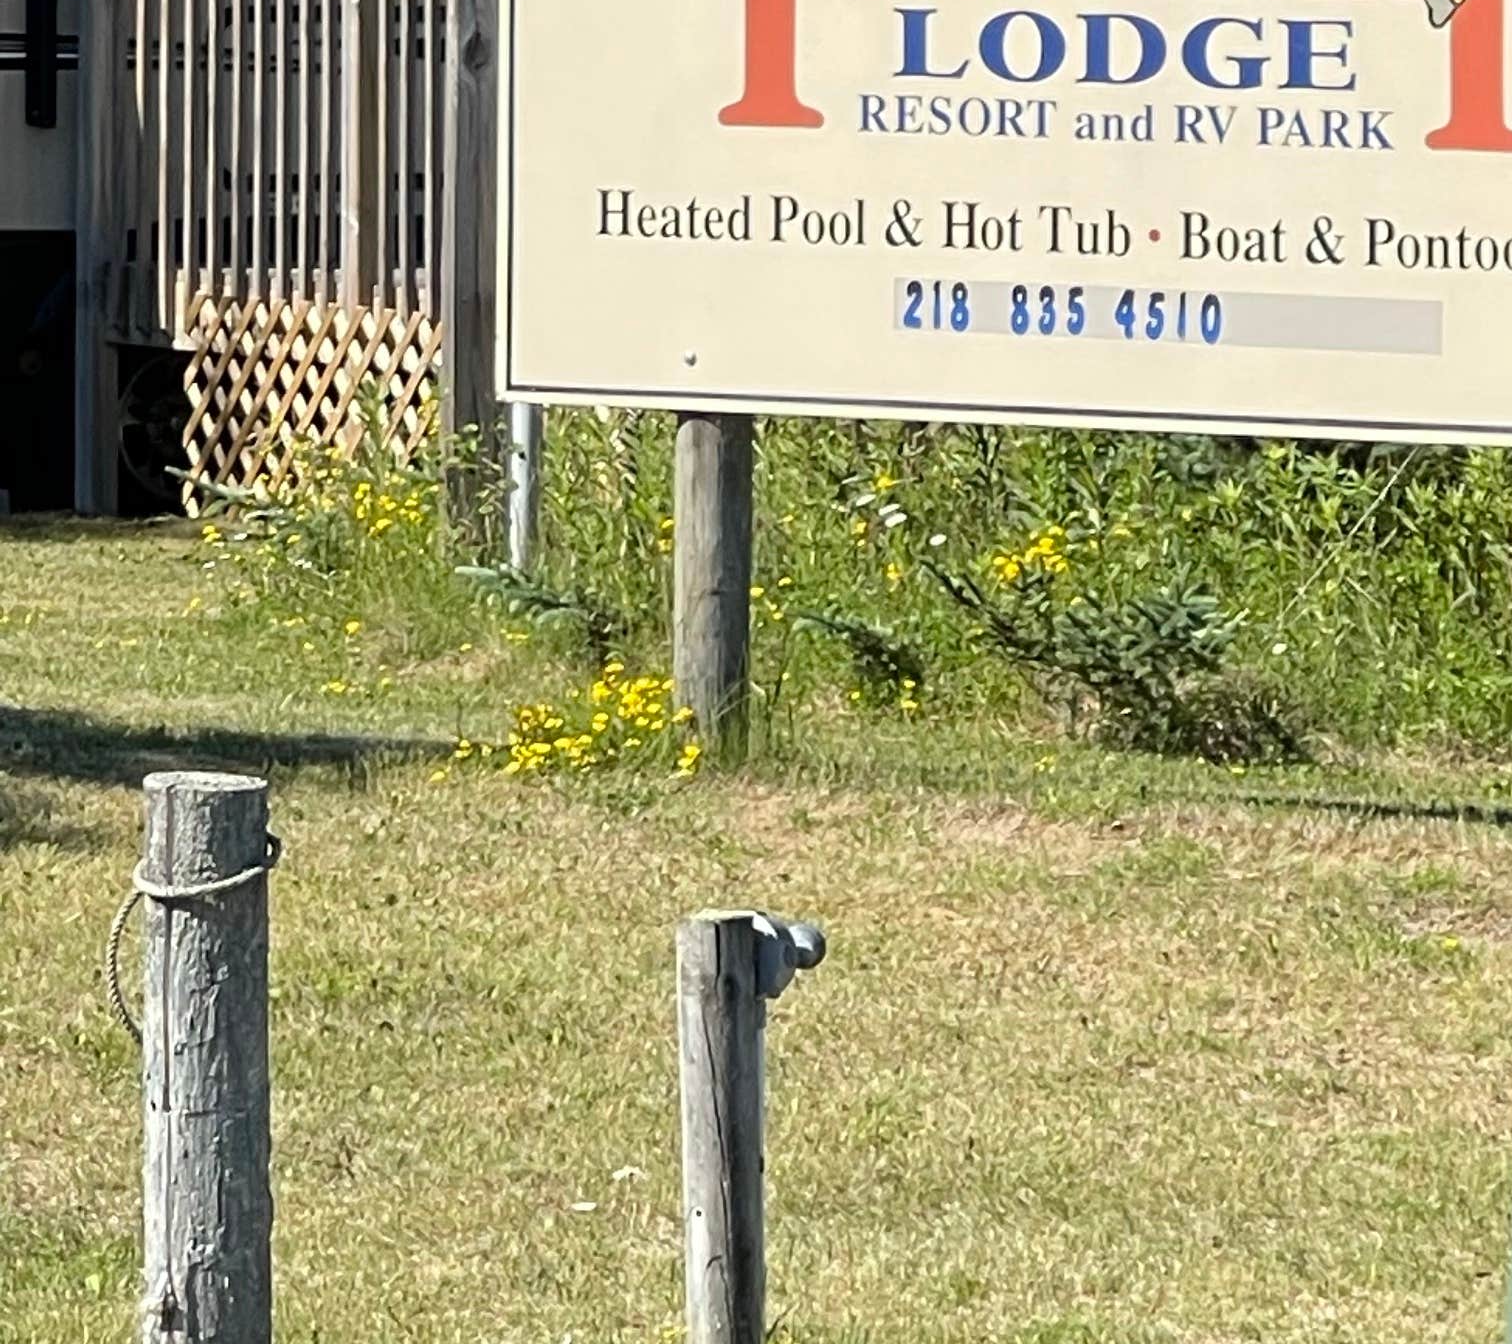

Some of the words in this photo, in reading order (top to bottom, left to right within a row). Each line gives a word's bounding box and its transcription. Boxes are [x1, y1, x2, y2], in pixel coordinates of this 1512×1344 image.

[893, 8, 1356, 91] LODGE
[859, 95, 1057, 137] RESORT
[1075, 105, 1154, 141] and
[1175, 105, 1237, 144] RV
[1258, 108, 1394, 150] PARK
[598, 189, 750, 241] Heated
[771, 196, 864, 245] Pool
[885, 200, 922, 247] &
[943, 202, 1021, 251] Hot
[1039, 206, 1130, 256] Tub
[1181, 212, 1286, 262] Boat
[1306, 216, 1344, 265] &
[904, 280, 969, 332] 218
[1011, 285, 1084, 335] 835
[1115, 289, 1221, 344] 4510
